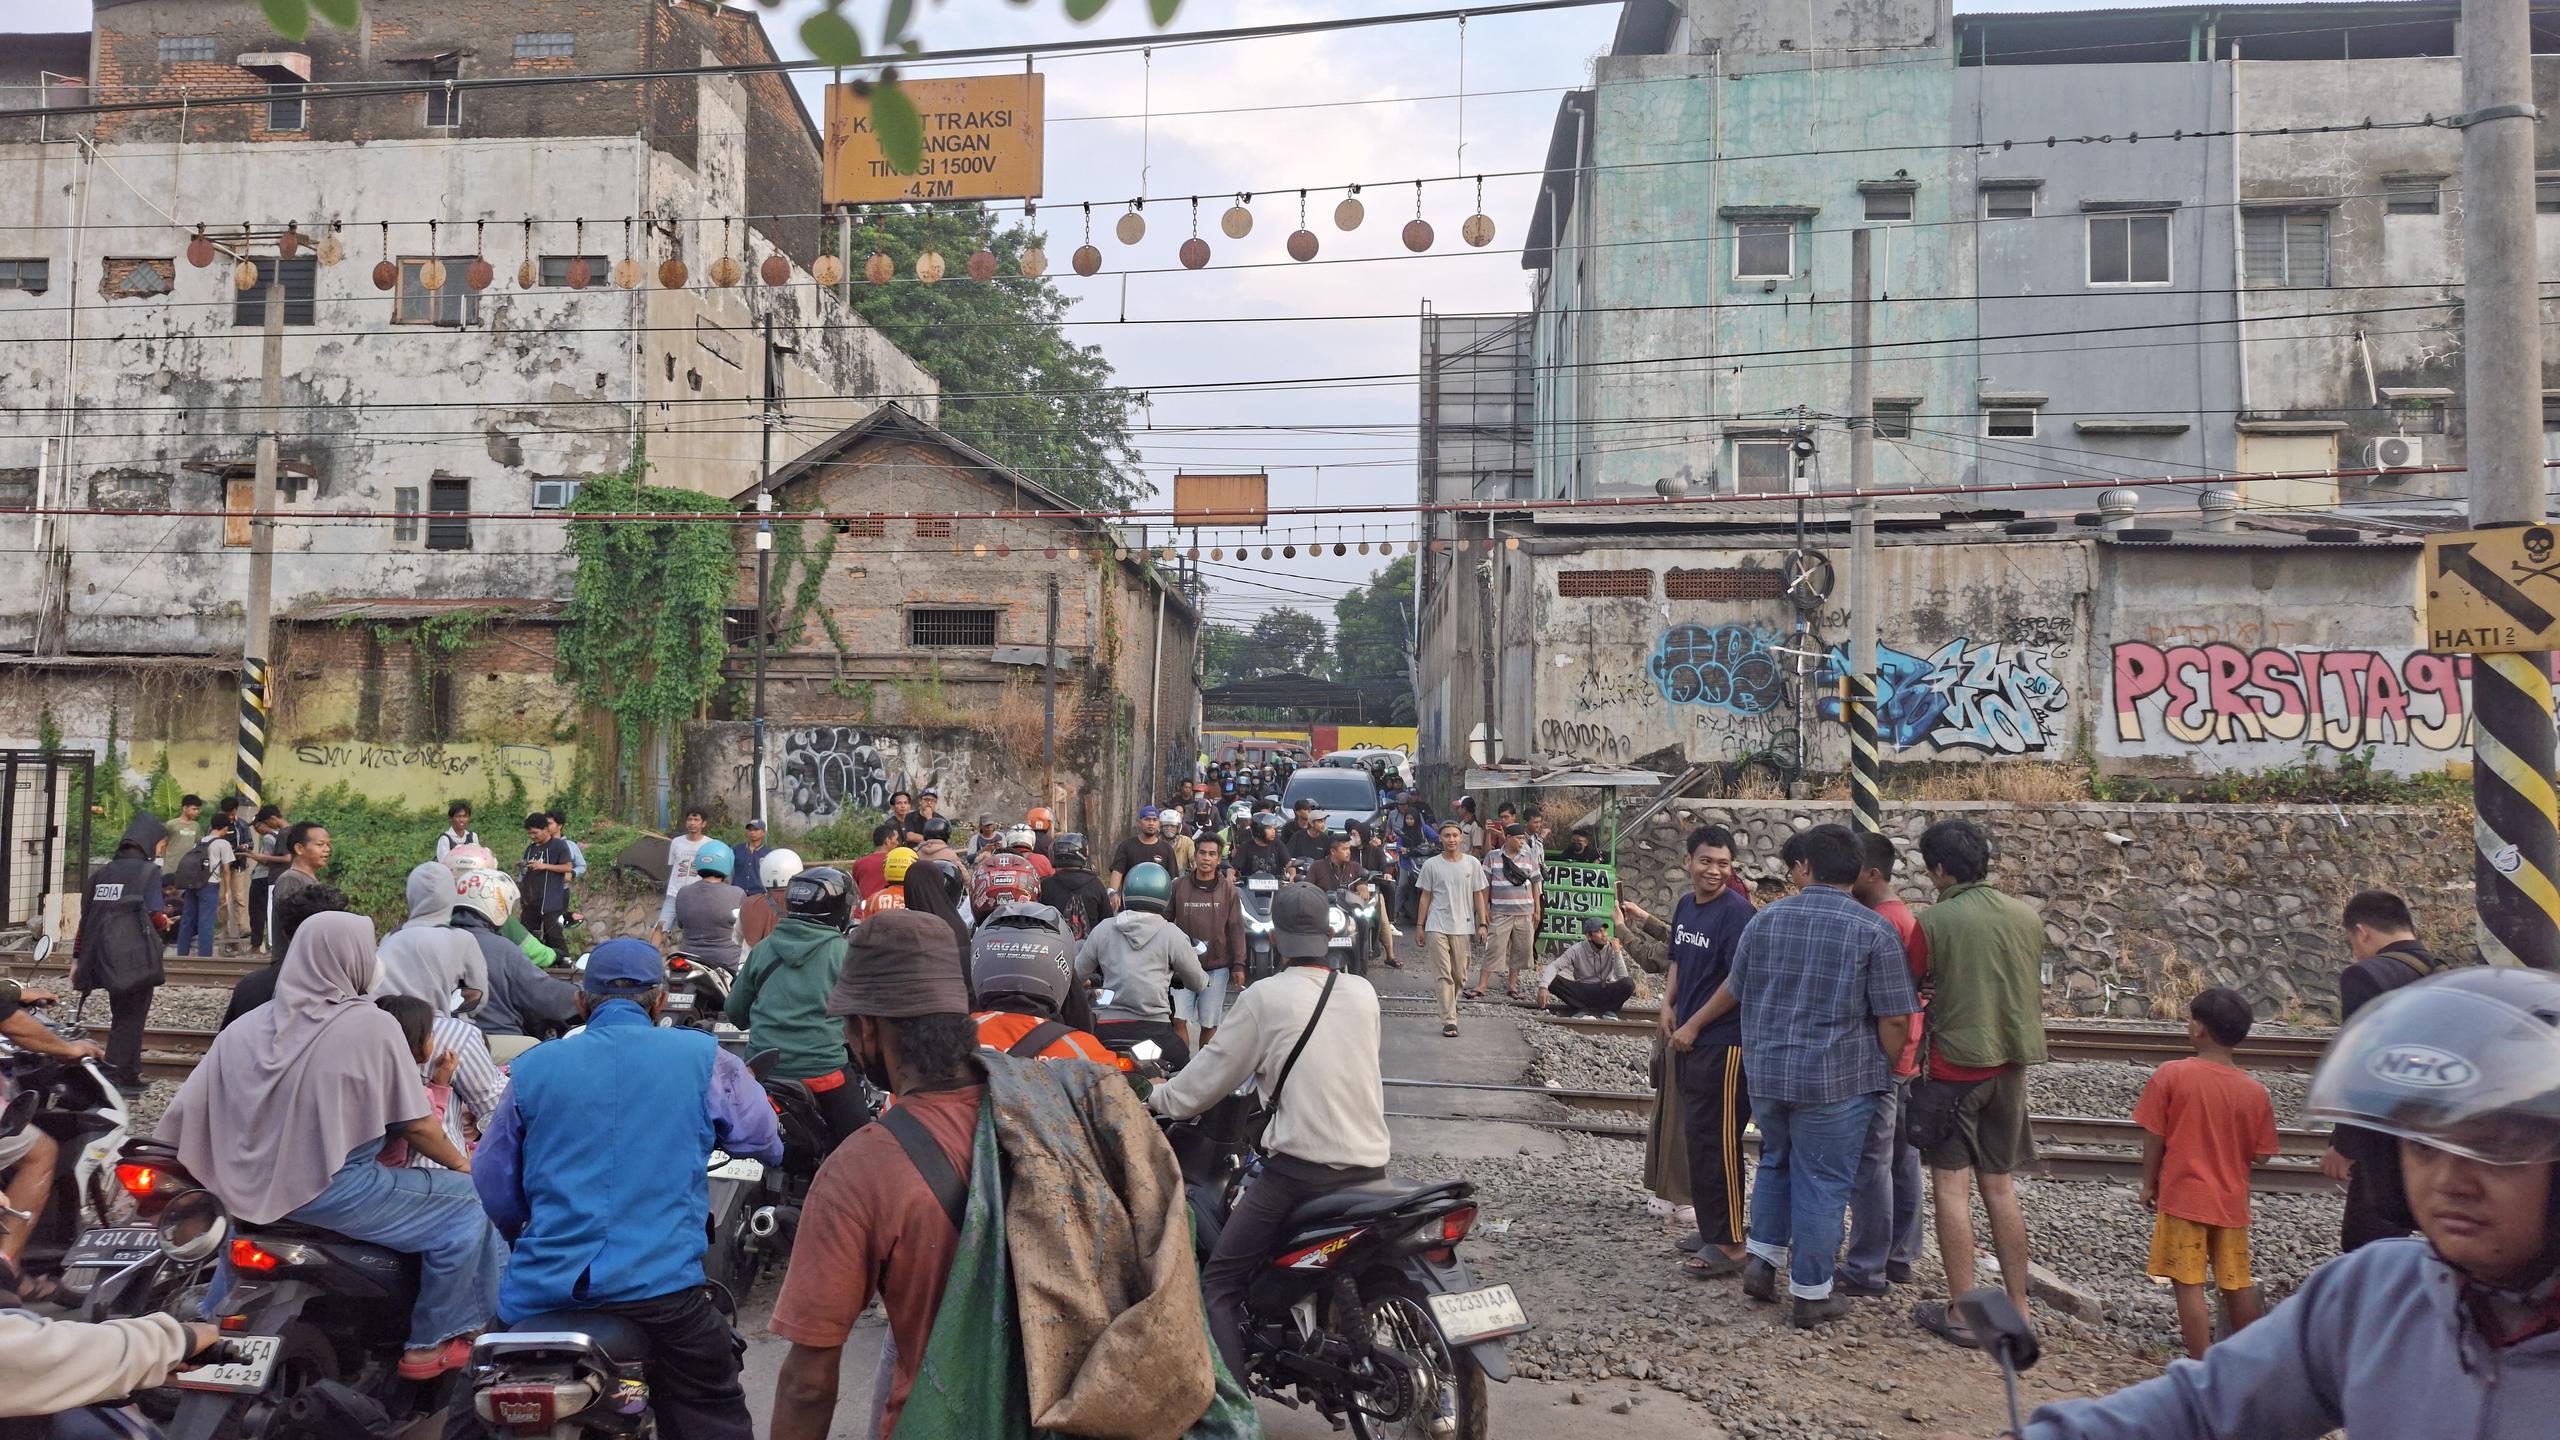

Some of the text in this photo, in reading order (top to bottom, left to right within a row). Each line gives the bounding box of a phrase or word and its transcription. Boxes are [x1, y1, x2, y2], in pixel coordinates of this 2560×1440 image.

[935, 111, 1012, 130] TRAKSI
[876, 135, 990, 154] TANGAN
[941, 156, 997, 174] 1500V
[2435, 627, 2499, 648] HATI
[96, 886, 119, 898] EDIA
[986, 942, 1049, 954] VAGANZA
[94, 1231, 132, 1246] 4314
